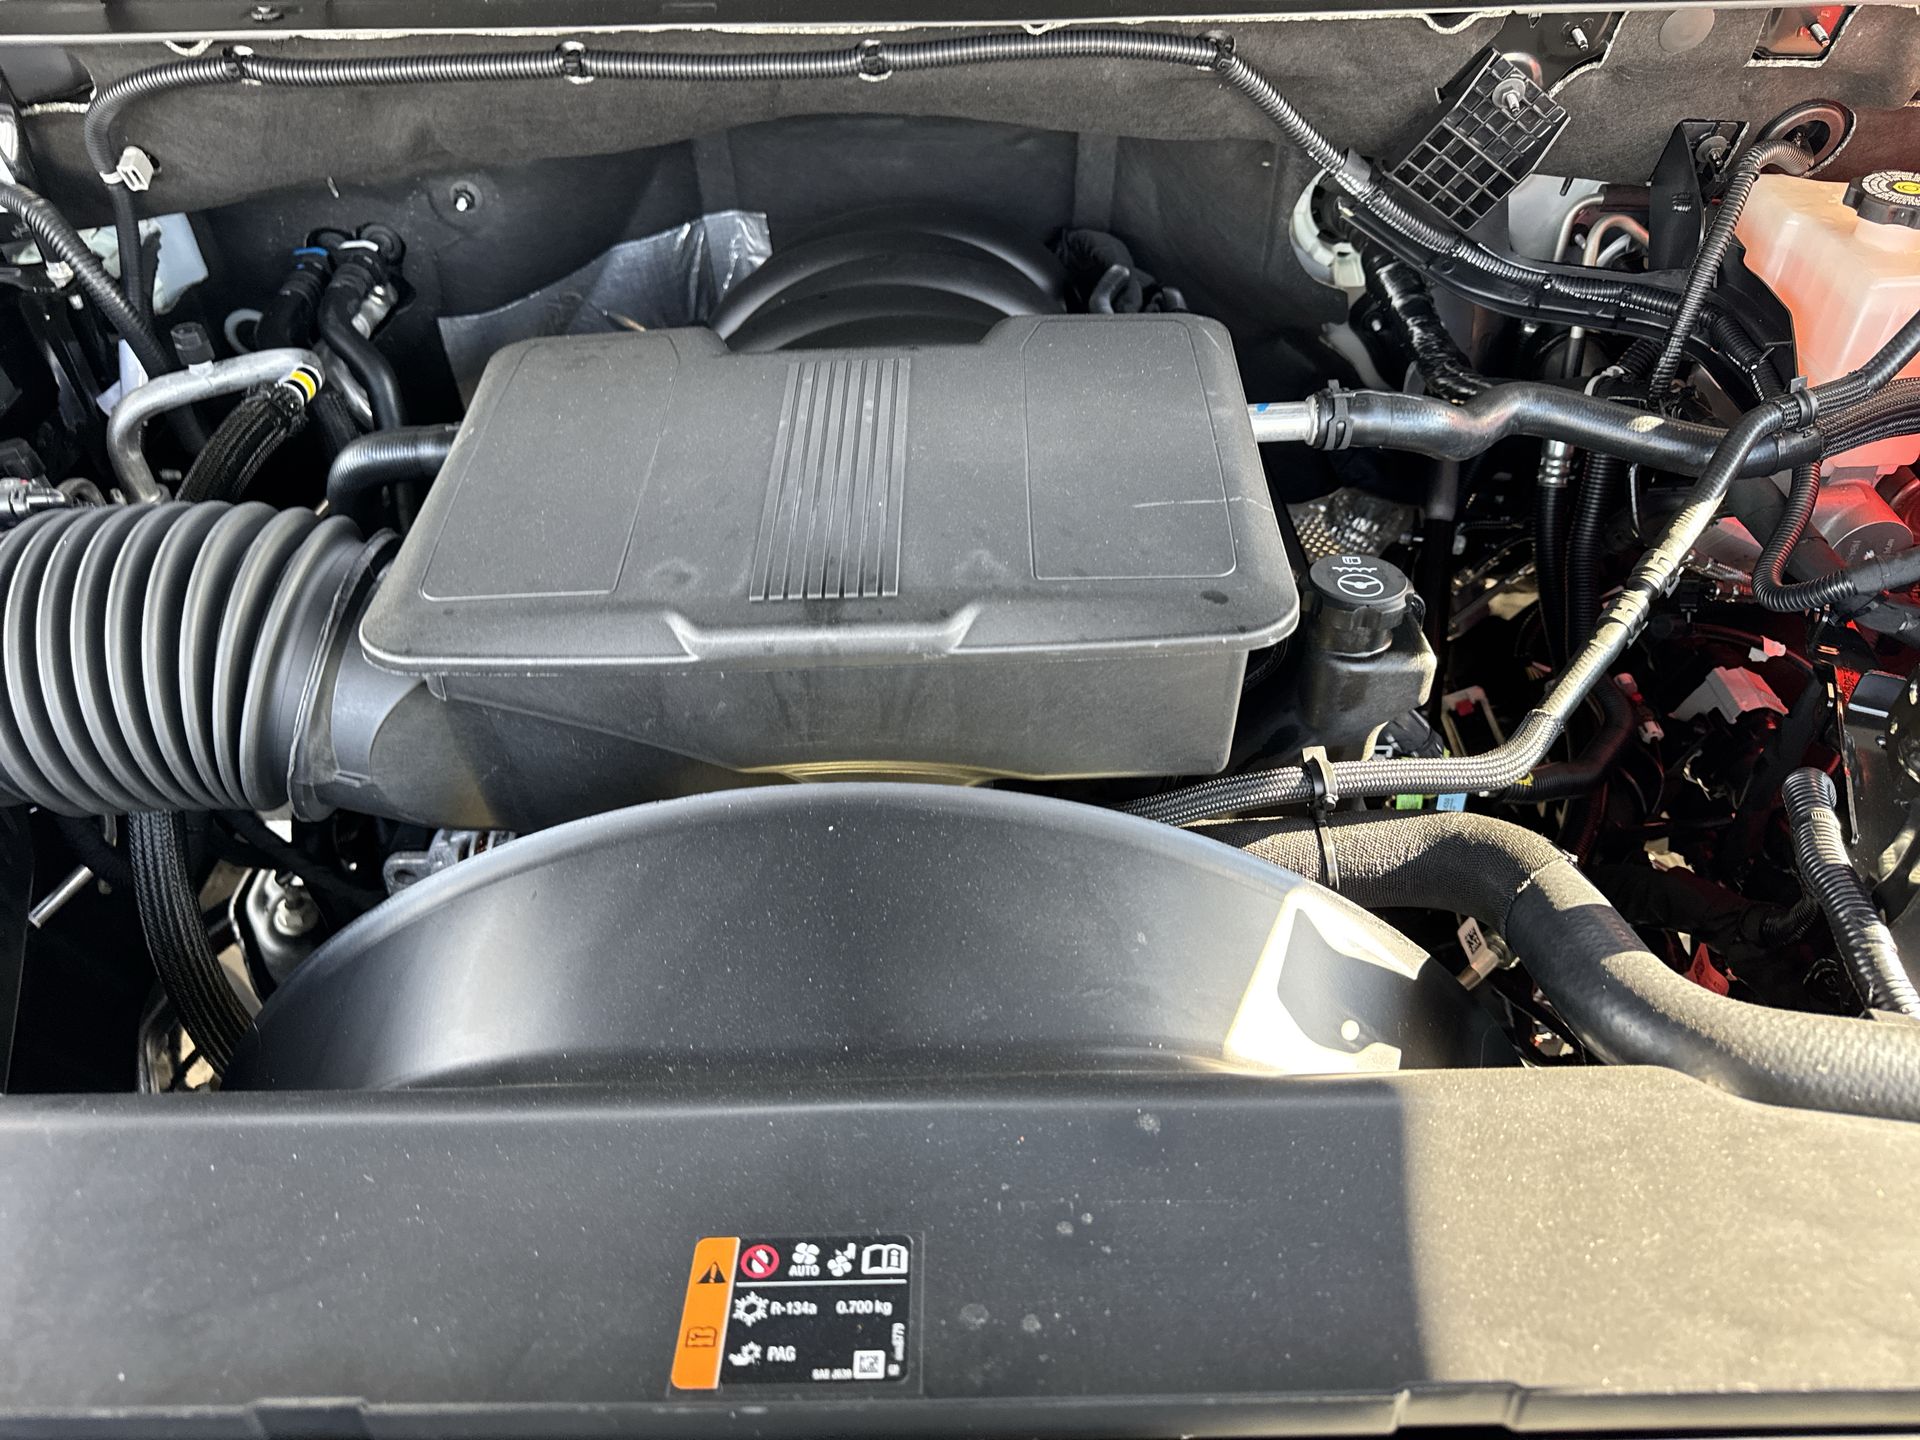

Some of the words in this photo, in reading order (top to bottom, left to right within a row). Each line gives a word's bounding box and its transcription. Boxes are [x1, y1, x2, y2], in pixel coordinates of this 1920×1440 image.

[788, 1264, 820, 1277] AUTO
[770, 1301, 818, 1315] R-134a
[835, 1299, 873, 1315] 0.700
[874, 1299, 893, 1316] kg
[766, 1346, 796, 1362] PAG
